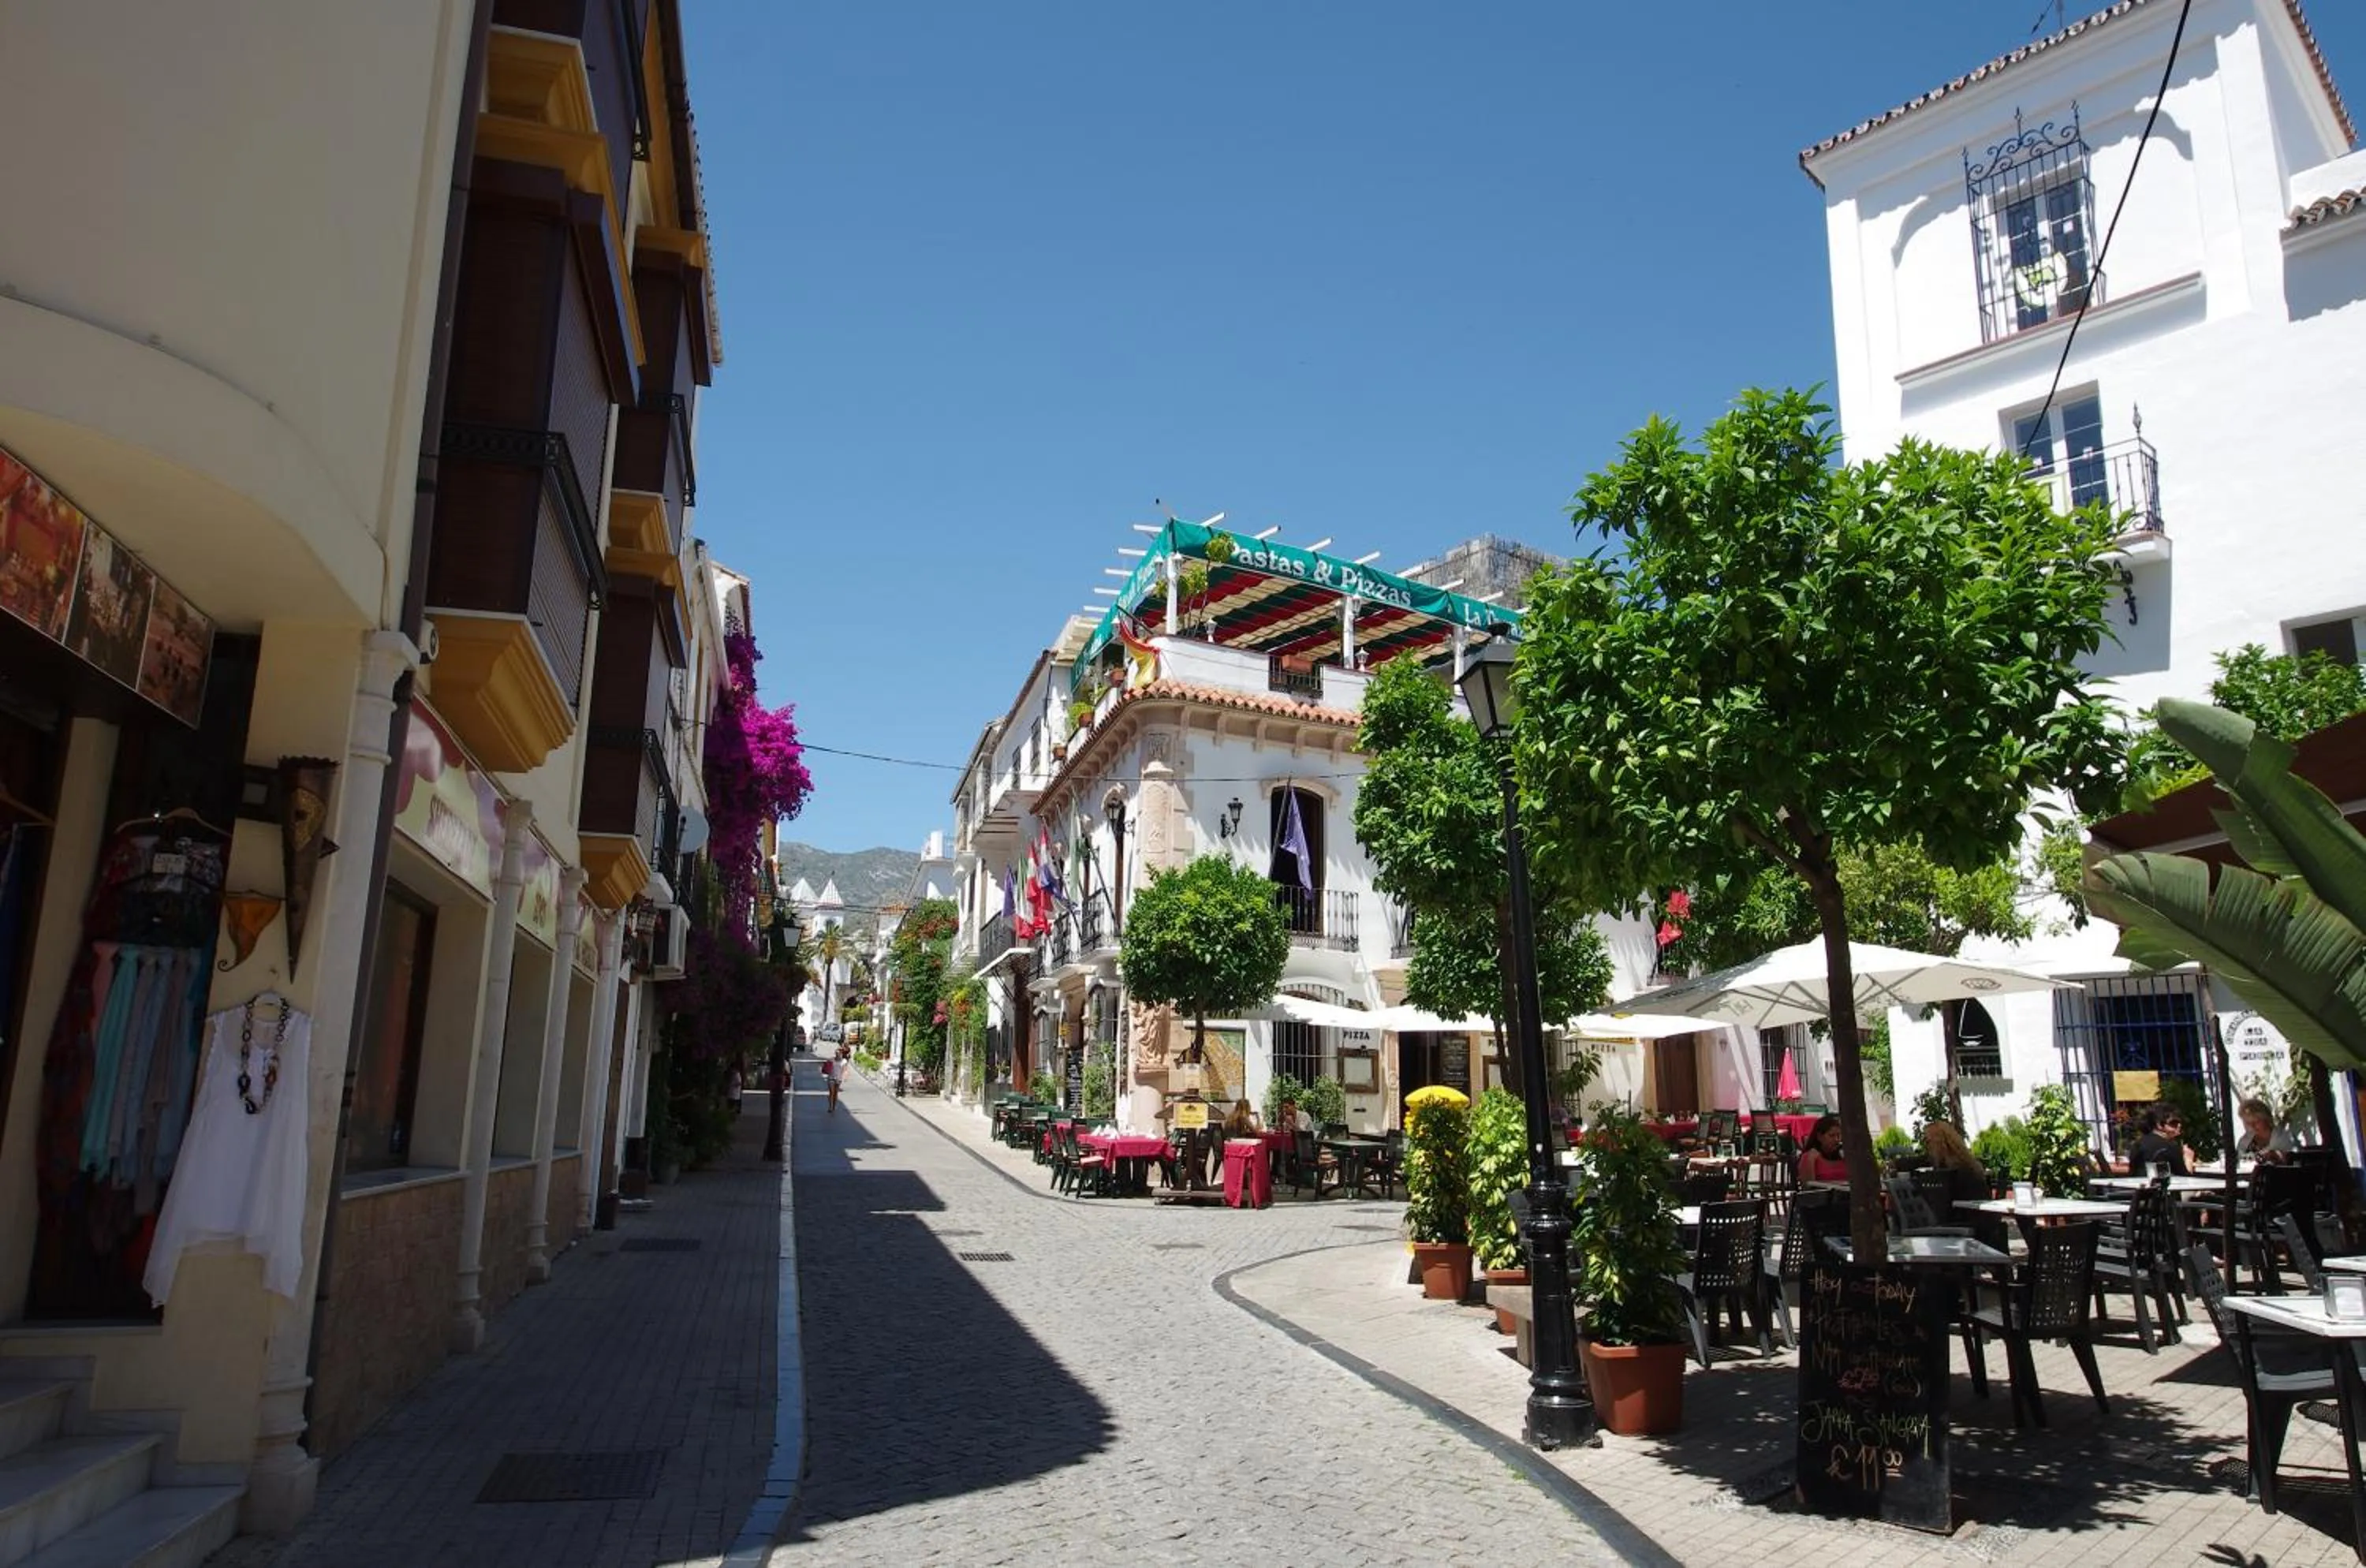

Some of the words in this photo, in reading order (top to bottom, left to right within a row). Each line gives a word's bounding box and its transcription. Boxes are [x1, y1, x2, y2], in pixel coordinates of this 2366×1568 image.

[1312, 559, 1334, 585] &
[1340, 566, 1412, 607] Pizzas
[1342, 1031, 1371, 1040] PIZZA
